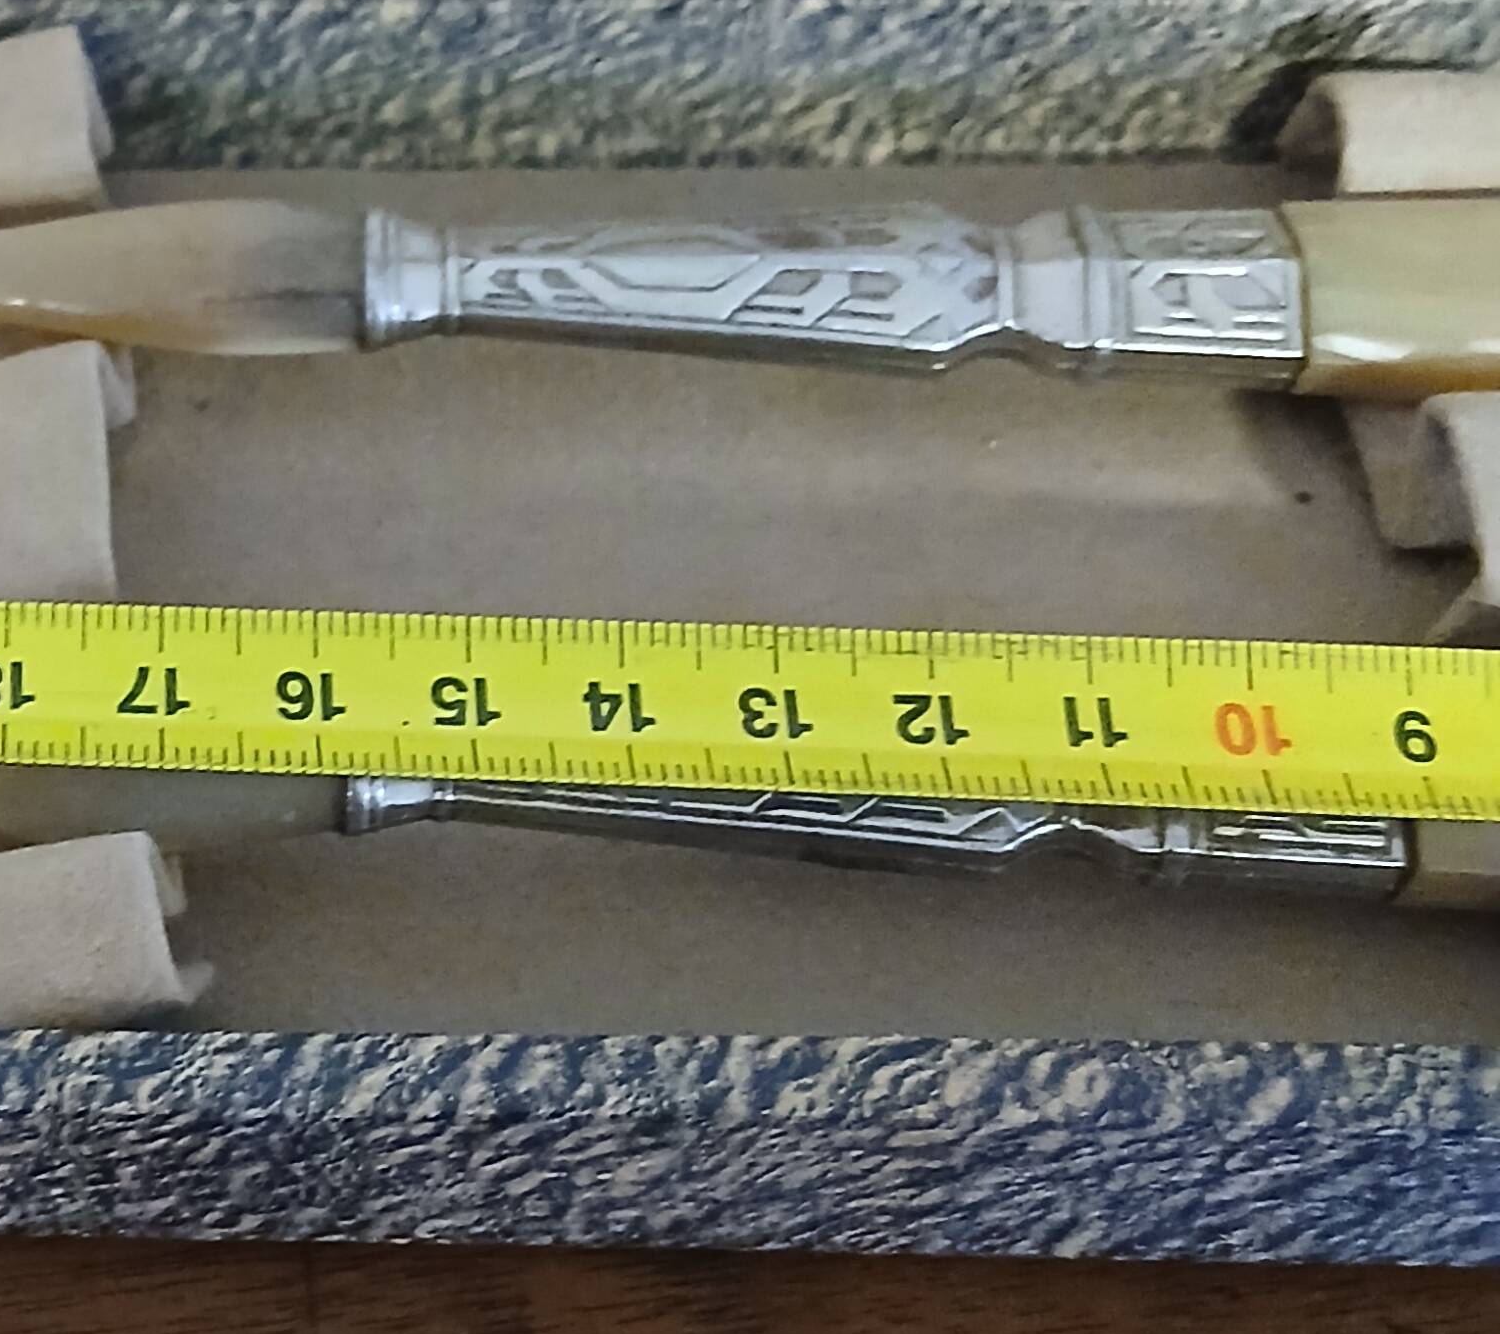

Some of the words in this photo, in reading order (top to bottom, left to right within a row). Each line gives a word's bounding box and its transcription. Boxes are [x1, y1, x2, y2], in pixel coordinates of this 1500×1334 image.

[115, 664, 192, 717] 17
[274, 670, 348, 723] 16
[429, 675, 503, 728] 15
[581, 680, 658, 734] 14
[737, 686, 815, 741] 13
[891, 693, 971, 747] 12
[1061, 695, 1130, 749] 11
[1213, 701, 1294, 758] 10
[1393, 709, 1439, 764] 9
